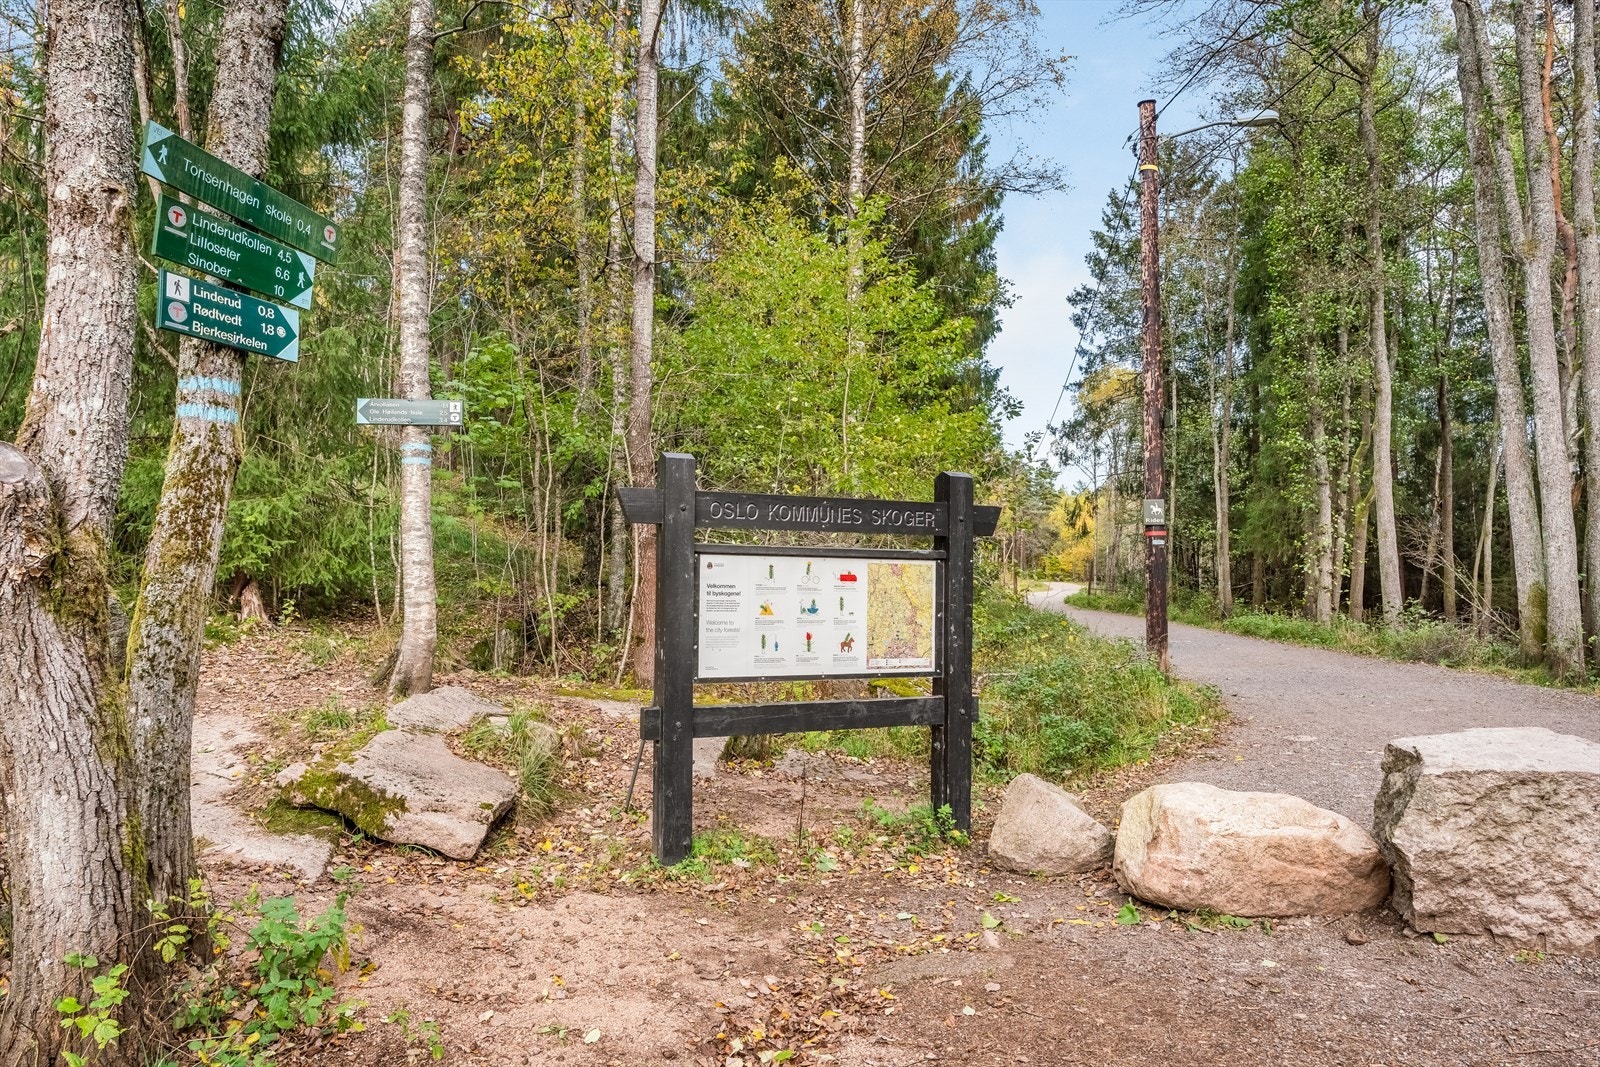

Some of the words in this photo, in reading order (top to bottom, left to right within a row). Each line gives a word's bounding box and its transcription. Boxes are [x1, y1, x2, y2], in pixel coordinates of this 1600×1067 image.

[183, 157, 261, 209] Tonsenhagen
[265, 204, 292, 226] skole
[189, 232, 241, 262] Lilloseter
[192, 213, 272, 256] Linderudkollen
[187, 252, 232, 278] Sinober
[274, 285, 285, 297] 10
[193, 285, 242, 310] Linderud
[193, 303, 242, 327] Rødtvedt
[192, 321, 268, 351] Bjerkesirkelen
[709, 502, 759, 521] OSLO
[768, 503, 863, 525] KOMMUNES
[871, 508, 935, 528] SKOGER
